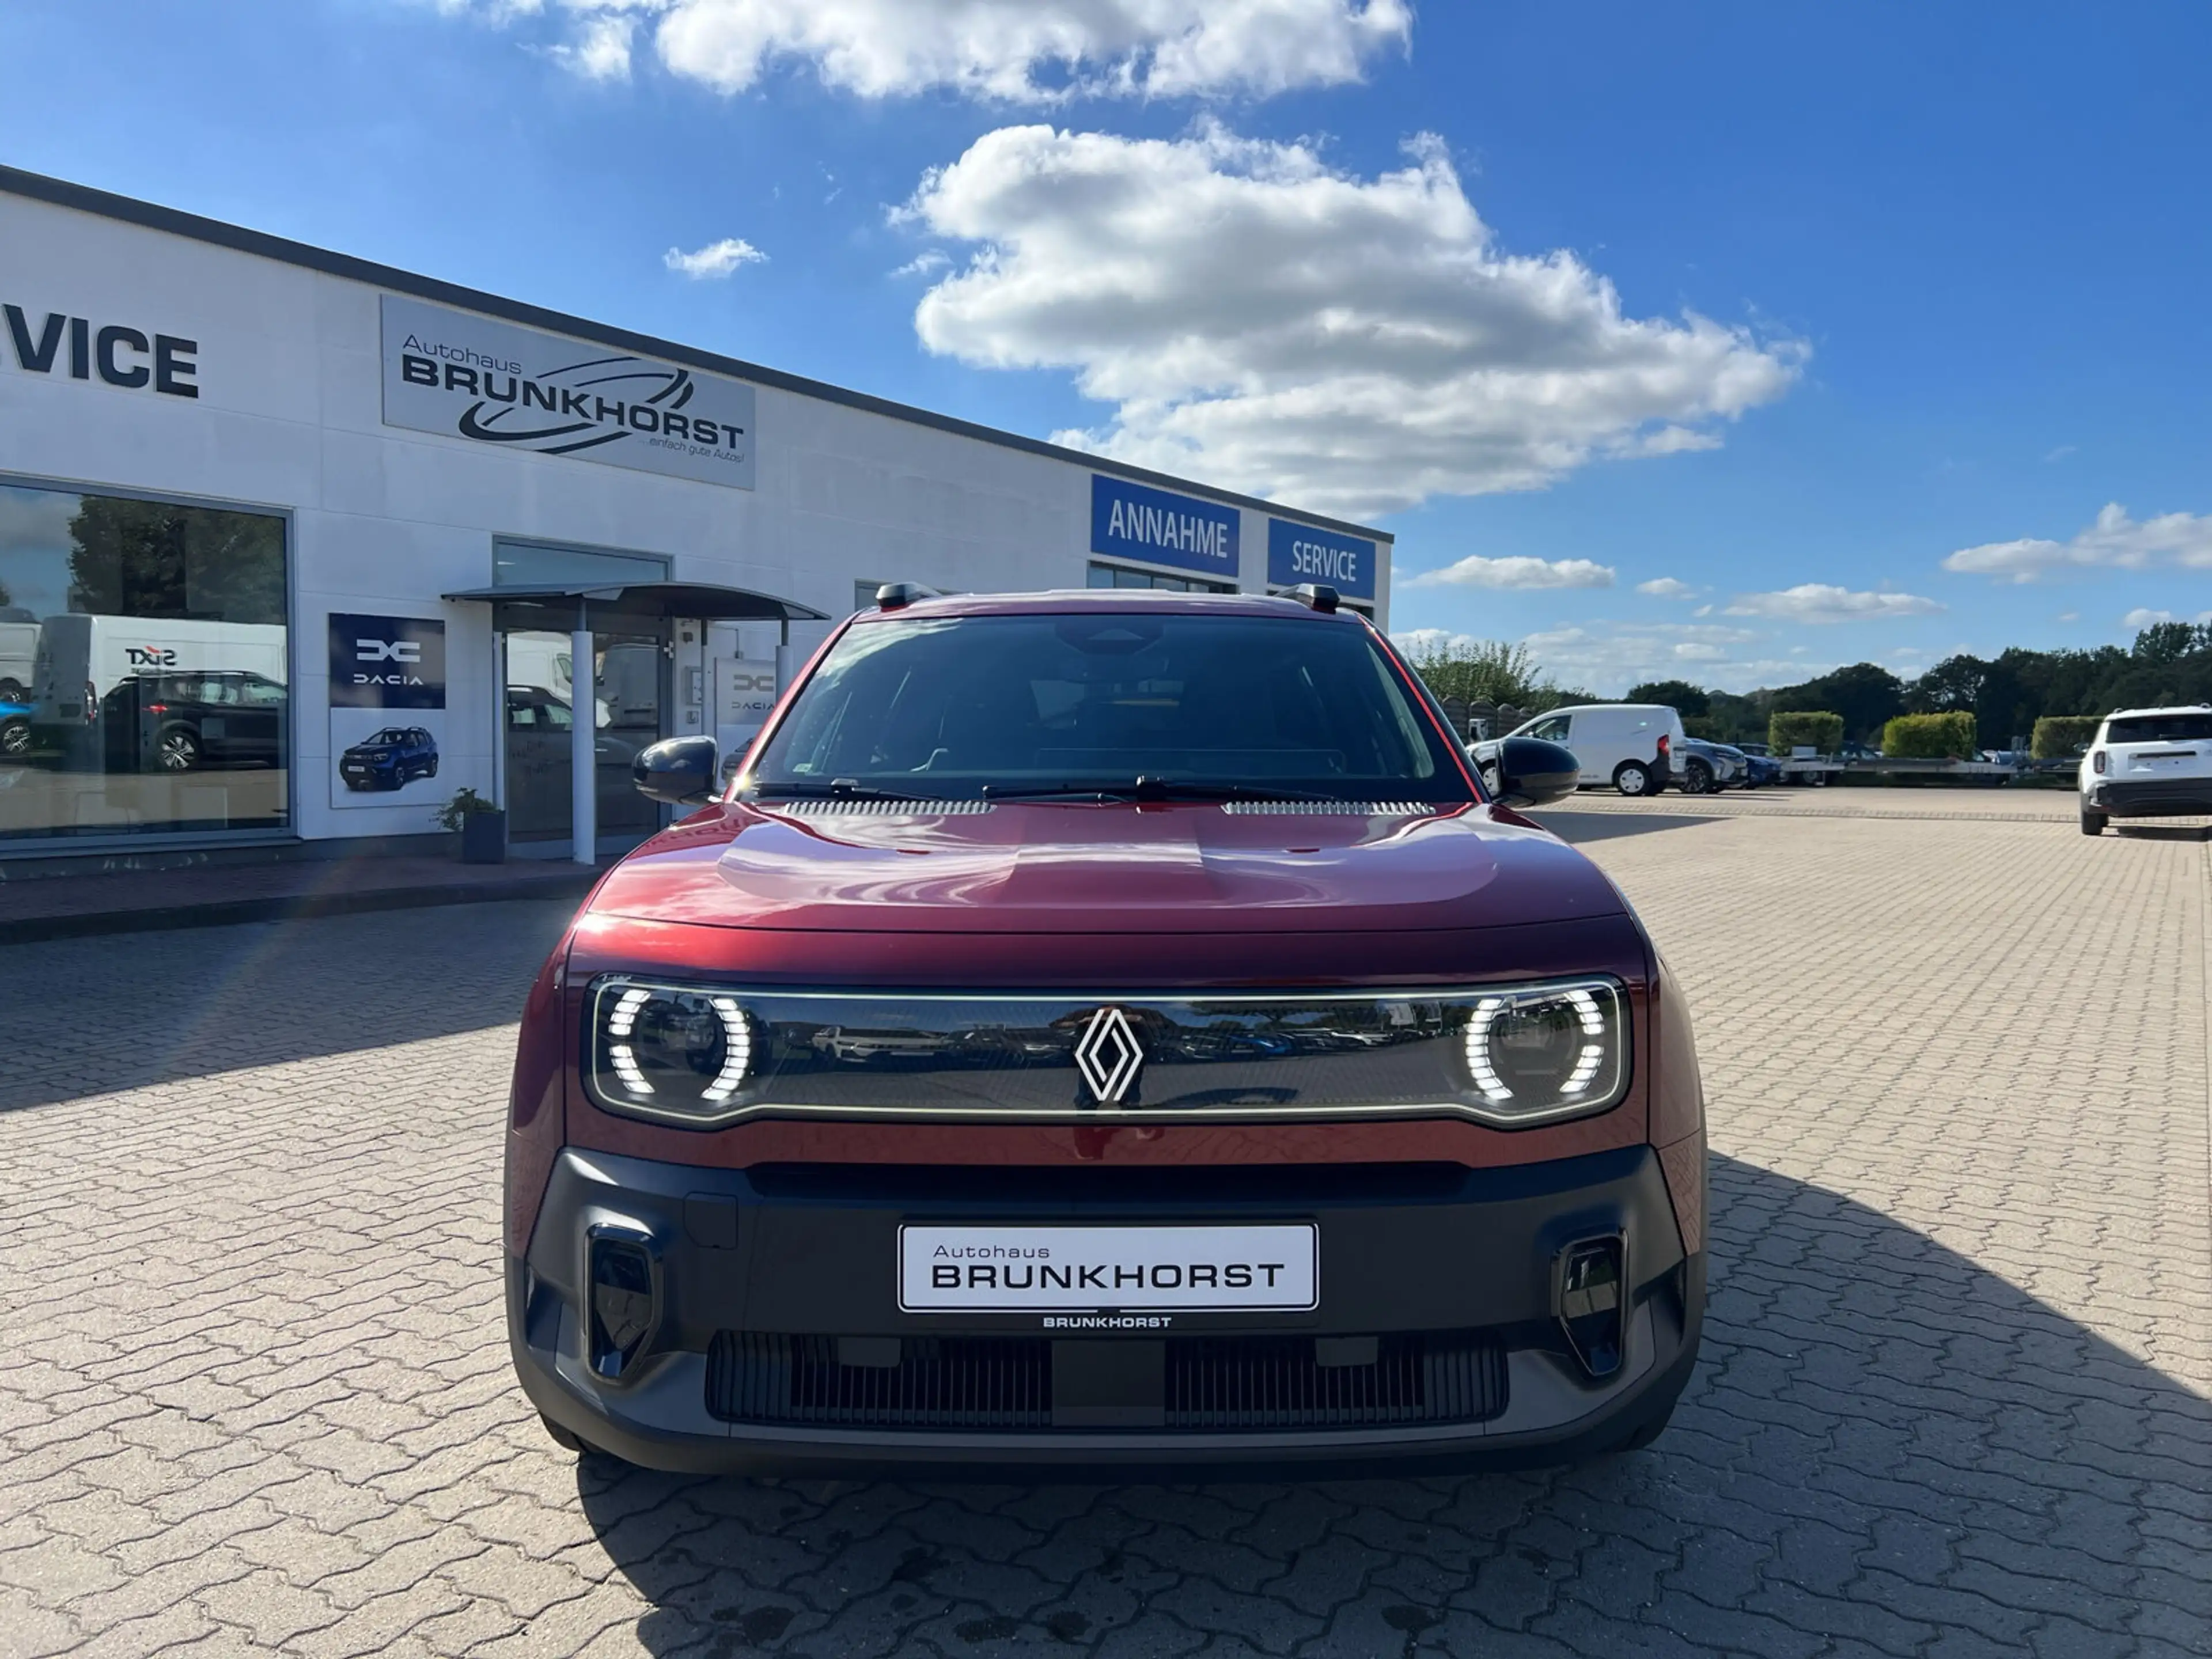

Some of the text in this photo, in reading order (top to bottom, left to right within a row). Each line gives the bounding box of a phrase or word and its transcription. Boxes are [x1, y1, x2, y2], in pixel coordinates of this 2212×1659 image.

[403, 334, 522, 374] Autohaus
[402, 354, 744, 449] BRUNKHORST
[1108, 499, 1228, 558] ANNAHME
[1292, 540, 1357, 582] SERVICE
[353, 673, 424, 685] DACIA
[731, 701, 775, 710] DACIA
[933, 1245, 1050, 1259] Autohaus
[932, 1263, 1285, 1289] BRUNKHORST
[1043, 1317, 1172, 1328] BRUNKHORST
